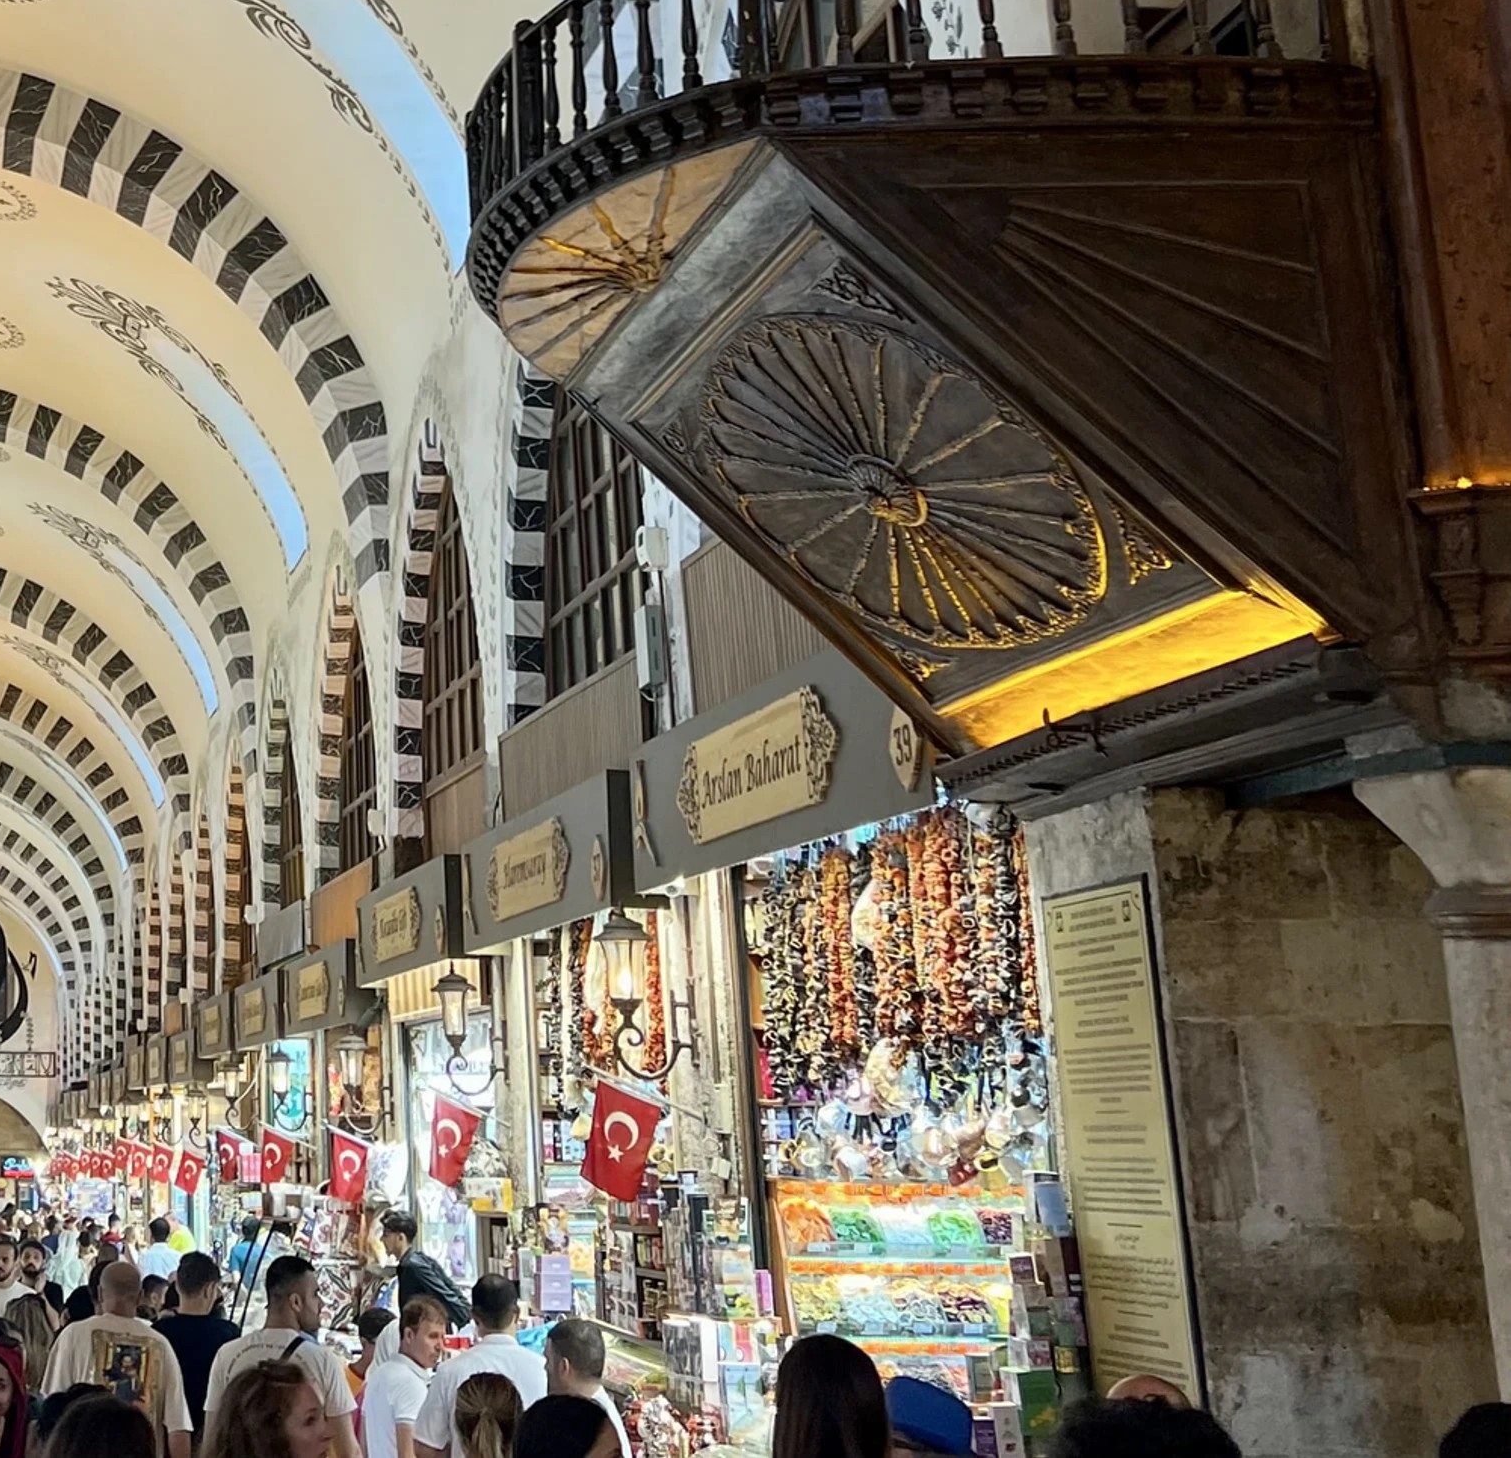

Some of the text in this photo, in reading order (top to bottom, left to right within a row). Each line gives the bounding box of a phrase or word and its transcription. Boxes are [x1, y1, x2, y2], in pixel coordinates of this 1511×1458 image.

[702, 735, 801, 809] Arslan Baharat
[893, 724, 912, 766] 39
